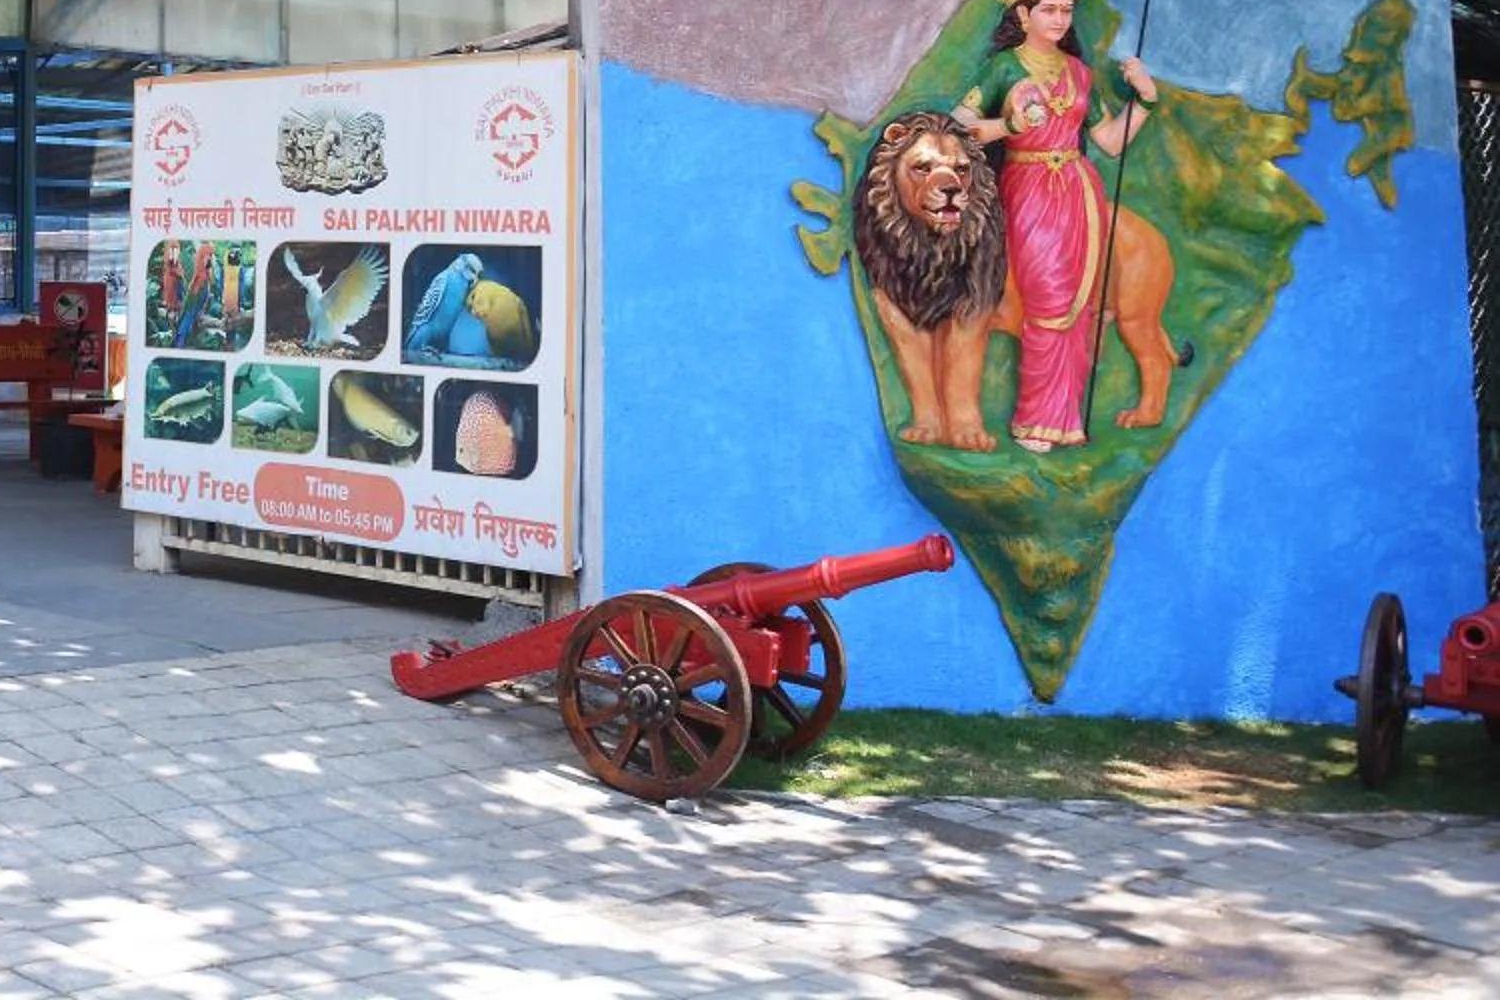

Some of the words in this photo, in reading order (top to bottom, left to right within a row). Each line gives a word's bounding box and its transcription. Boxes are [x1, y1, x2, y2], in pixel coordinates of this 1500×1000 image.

[143, 199, 173, 233] साई
[178, 199, 235, 229] पालखी
[241, 198, 295, 229] निवारा
[323, 208, 357, 231] SAI
[365, 209, 446, 233] PALKHI
[454, 209, 552, 235] NIWARA
[131, 463, 191, 503] Entry
[198, 471, 250, 504] Free
[305, 475, 349, 501] Time
[260, 500, 295, 518] 08:00
[297, 504, 317, 521] AM
[319, 508, 332, 523] to
[373, 515, 393, 534] PM
[412, 495, 465, 538] प्रवेश
